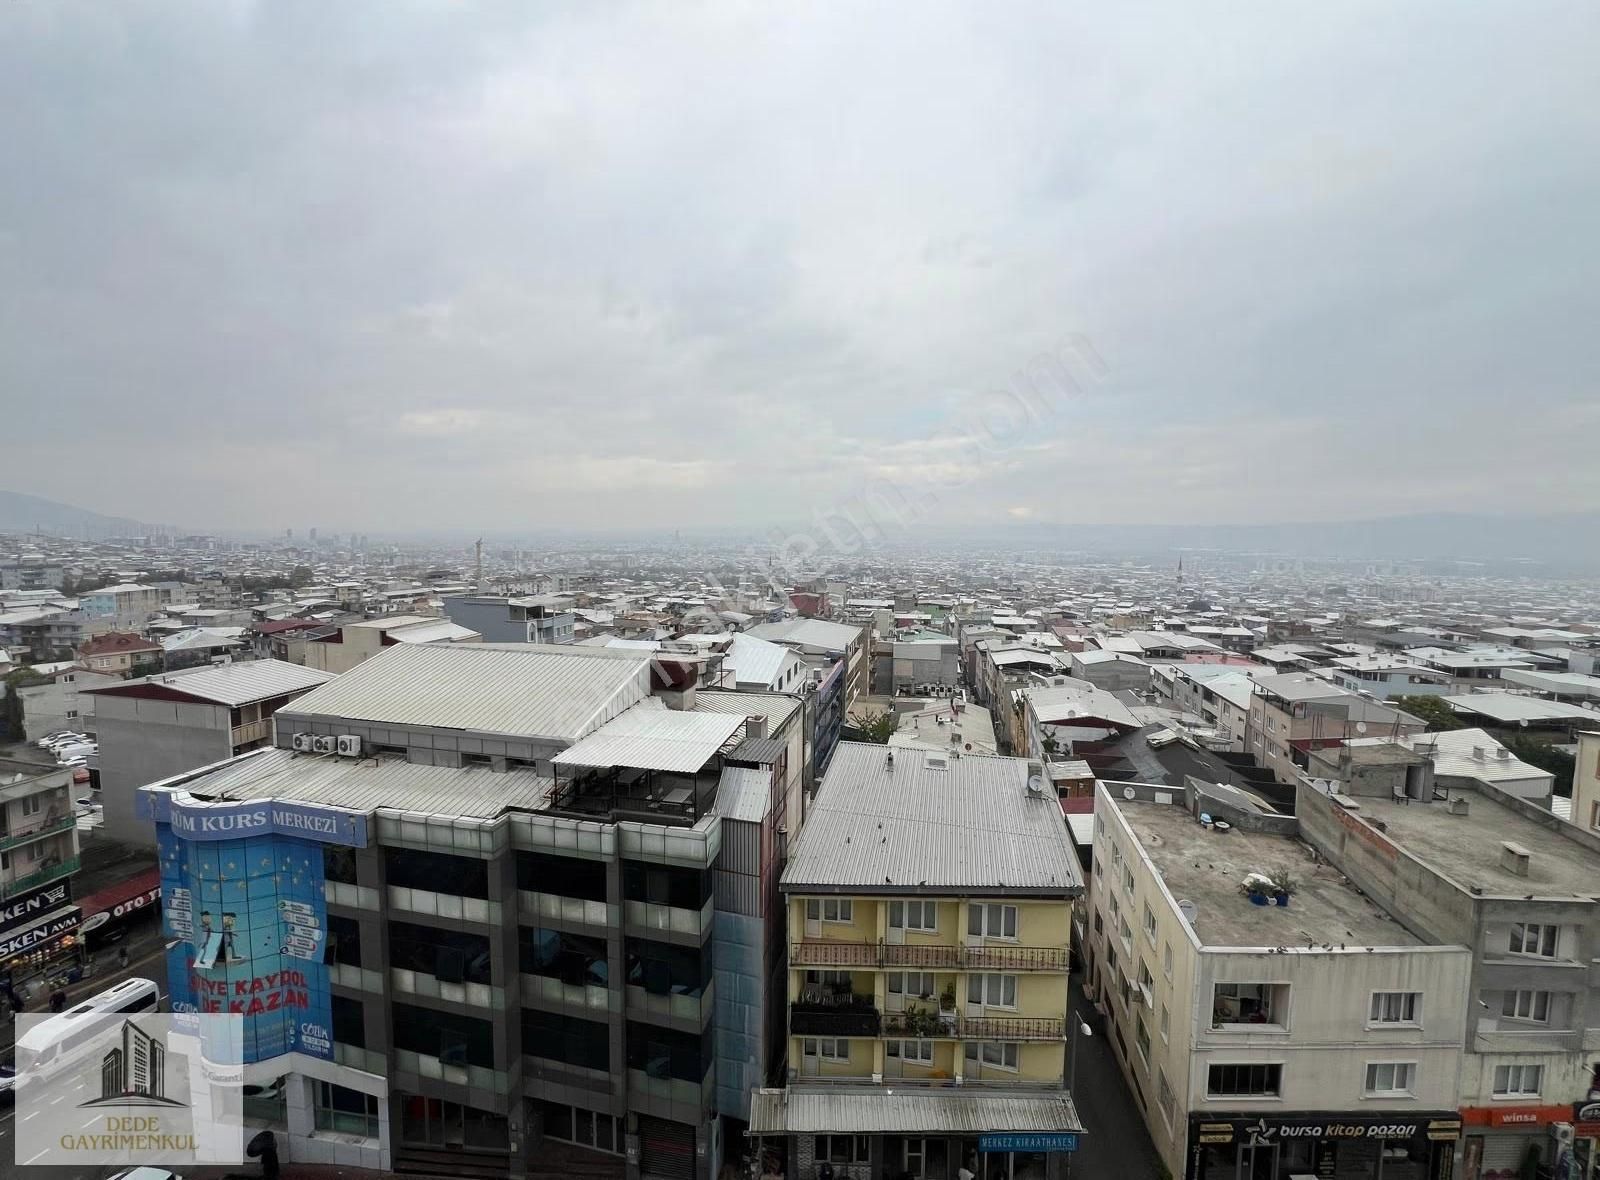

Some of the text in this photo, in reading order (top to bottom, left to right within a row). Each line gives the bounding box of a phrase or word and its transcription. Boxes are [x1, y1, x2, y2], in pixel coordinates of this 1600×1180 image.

[202, 811, 266, 832] KURS
[273, 810, 337, 834] MERKEZİ
[113, 896, 144, 917] OTO
[51, 916, 77, 933] AVM
[235, 970, 308, 996] KAYDOL
[230, 989, 309, 1017] KAZAN
[1502, 1112, 1537, 1122] winsa
[1280, 1125, 1322, 1137] bursa
[1324, 1124, 1365, 1137] kitap
[1367, 1125, 1417, 1137] pazarı
[982, 1137, 1012, 1148] MERKEZ
